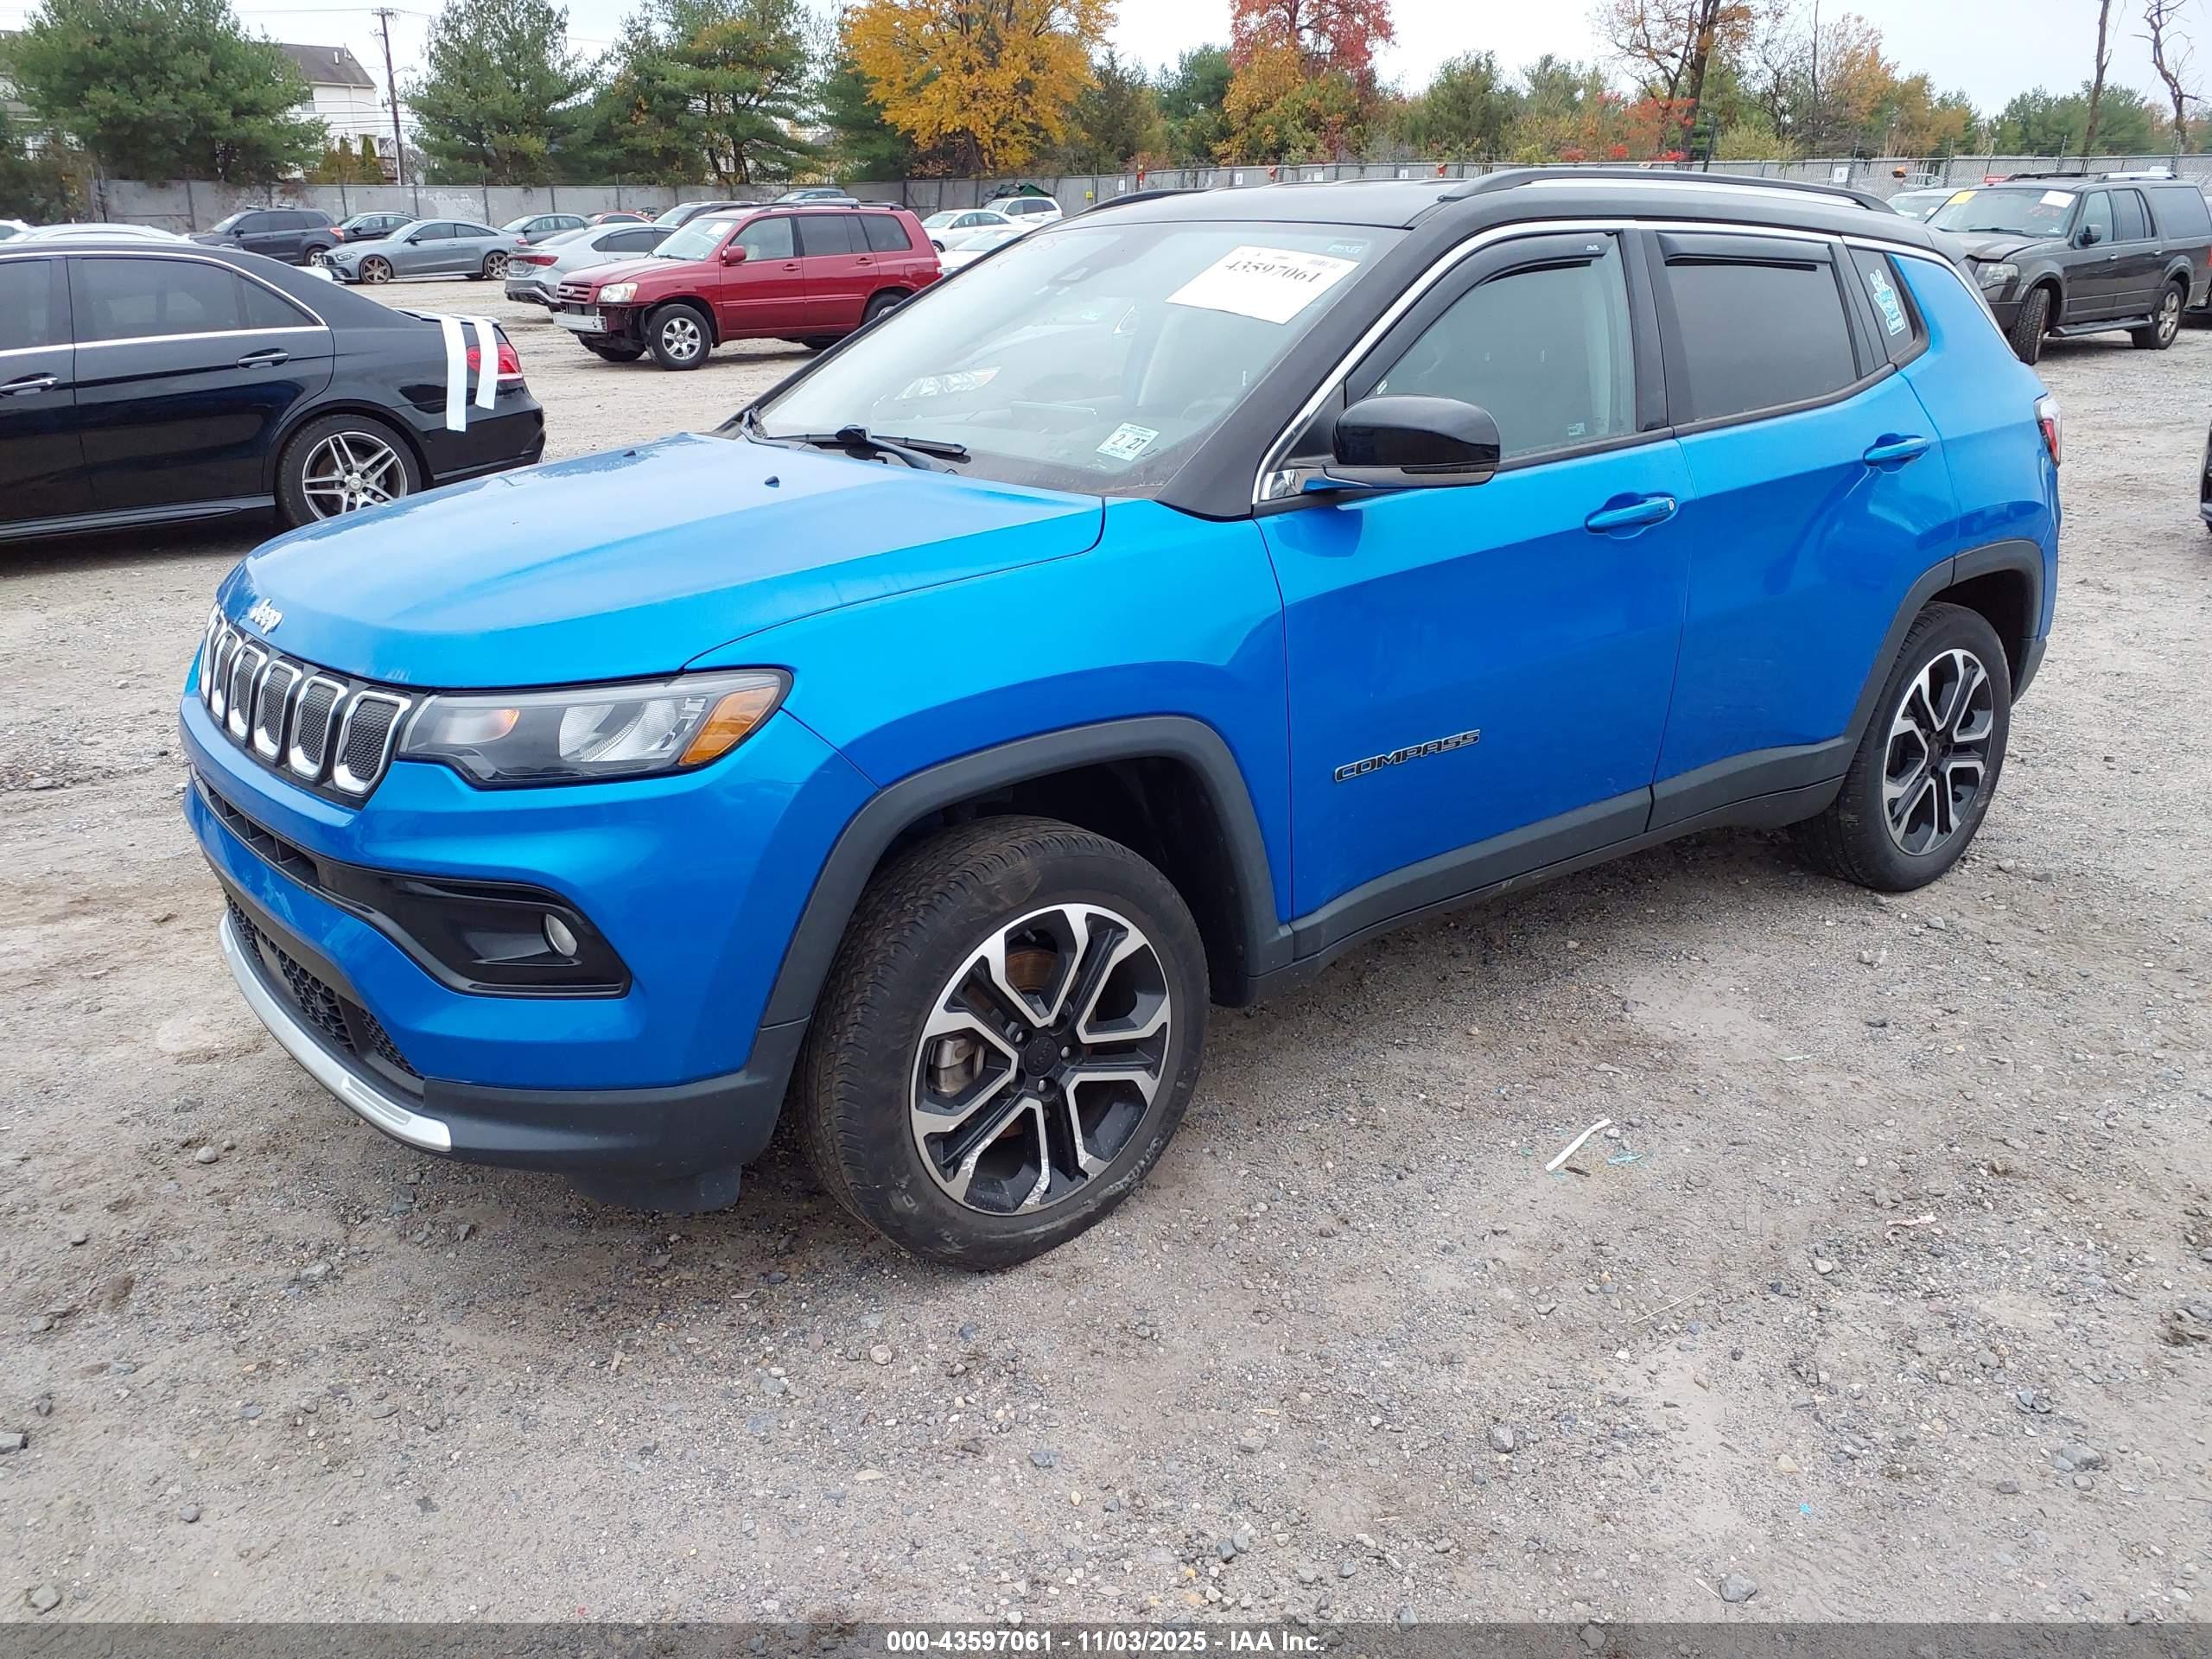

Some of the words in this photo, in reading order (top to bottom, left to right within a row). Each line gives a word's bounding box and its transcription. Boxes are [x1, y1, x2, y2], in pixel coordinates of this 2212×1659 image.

[1225, 260, 1322, 283] 43597061
[1112, 434, 1126, 445] 2
[1126, 438, 1147, 450] 27
[249, 598, 283, 636] Jeep
[1334, 728, 1480, 782] COMPASS
